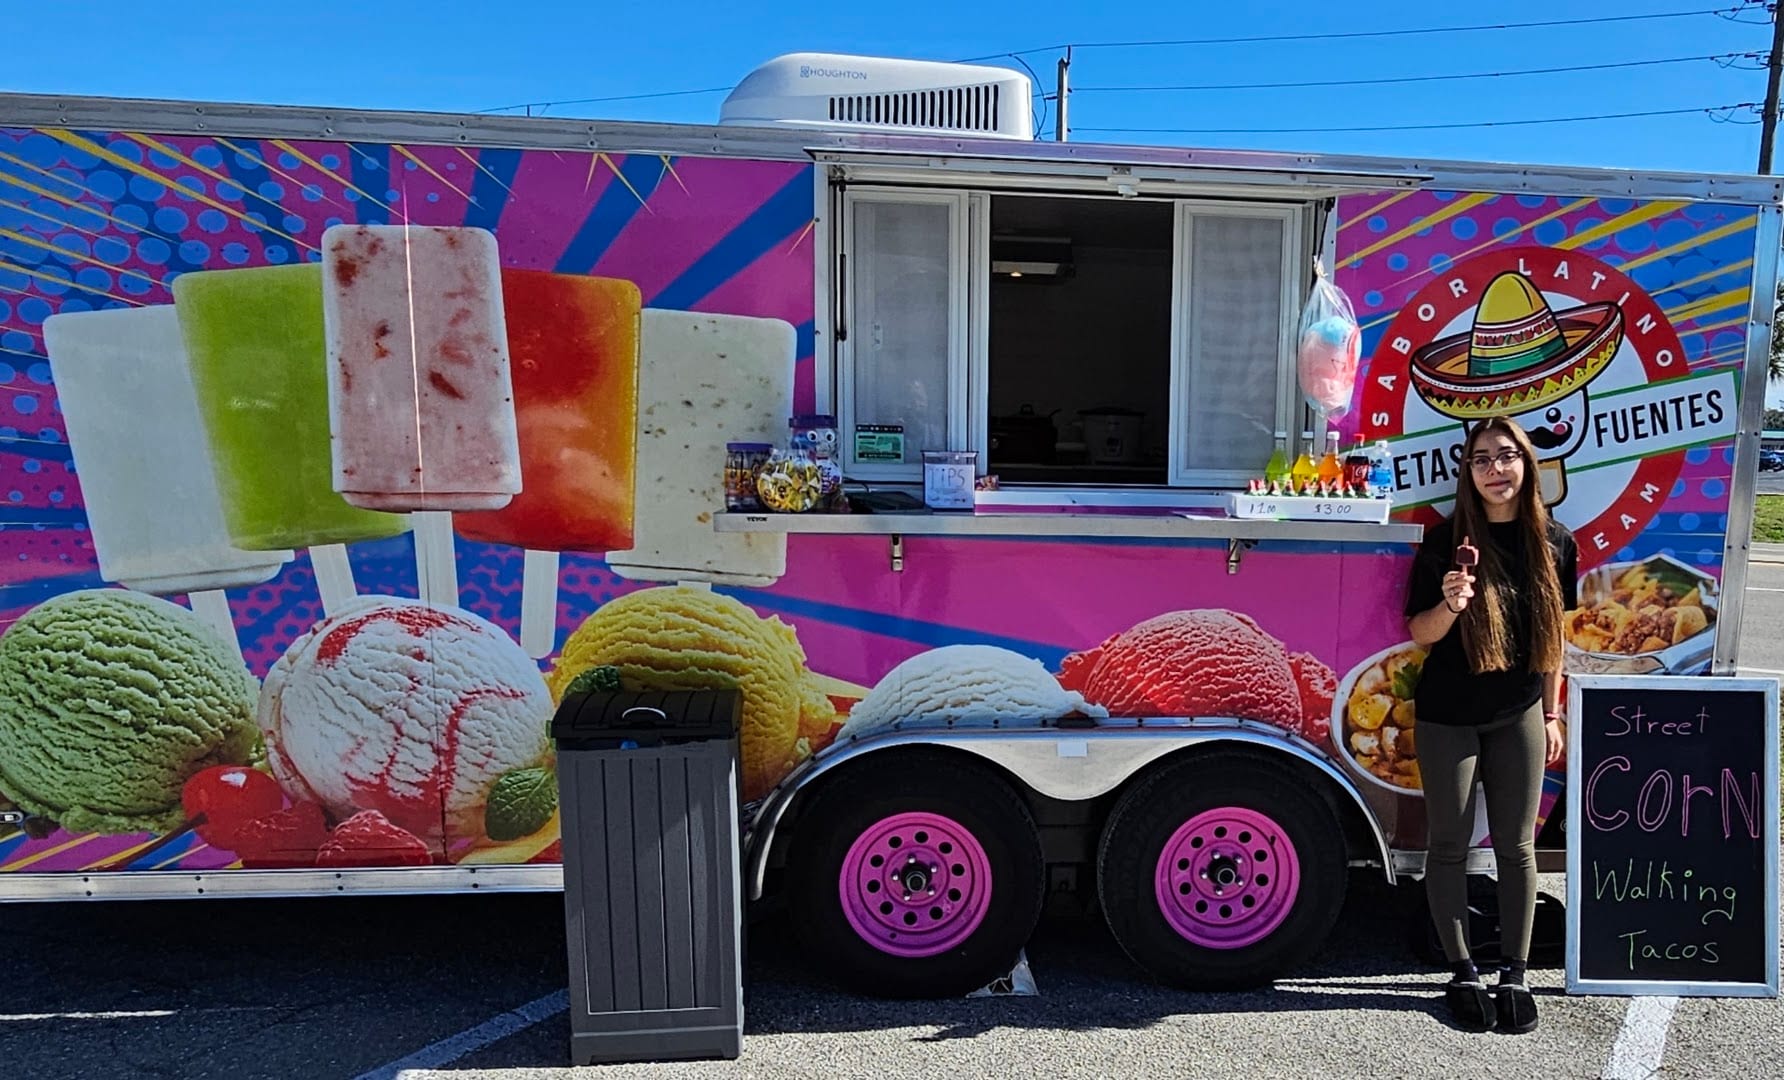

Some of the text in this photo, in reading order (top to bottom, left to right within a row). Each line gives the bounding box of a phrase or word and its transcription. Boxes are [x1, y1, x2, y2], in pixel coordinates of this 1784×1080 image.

[810, 68, 867, 79] HOUGHTON
[1372, 258, 1674, 427] SABOR LATINO
[1389, 388, 1723, 491] ETAS FUENTES
[1604, 706, 1711, 736] Street
[1593, 857, 1737, 926] Walking
[1618, 929, 1719, 971] Tacos
